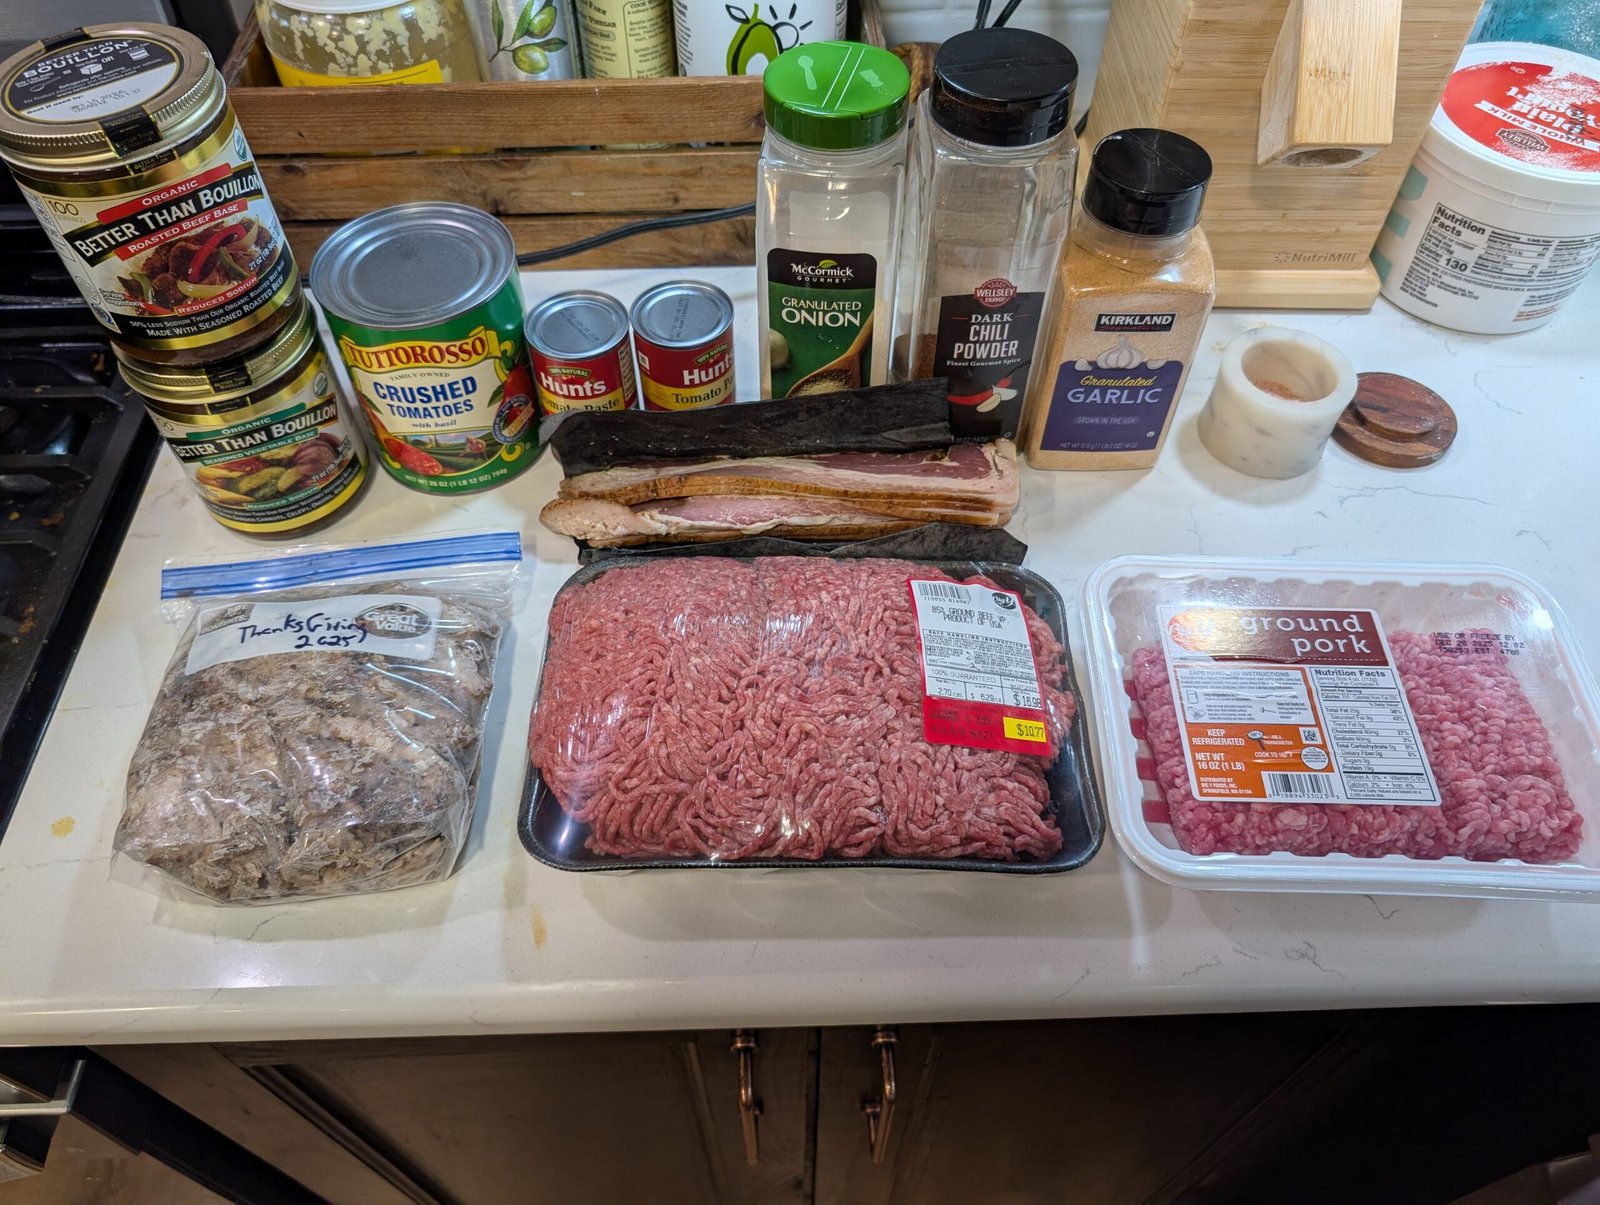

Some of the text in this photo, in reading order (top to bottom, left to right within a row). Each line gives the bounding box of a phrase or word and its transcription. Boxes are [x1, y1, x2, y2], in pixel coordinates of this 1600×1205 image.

[23, 41, 129, 78] BOUILLON
[38, 51, 80, 67] BETTER
[82, 42, 112, 53] THAN
[101, 56, 115, 64] OR
[1486, 106, 1586, 146] WHOLE MILK
[1499, 131, 1546, 151] WELLSLEY
[142, 179, 198, 206] ORGANIC
[49, 200, 79, 216] 100
[74, 174, 261, 258] BETTER THAN BOUILLON
[1432, 215, 1462, 238] Facts
[1436, 206, 1486, 235] Nutrition
[128, 204, 239, 254] ROASTED BEEF BASE
[1292, 252, 1356, 263] NutriMill
[1445, 257, 1468, 272] 130
[248, 262, 256, 271] 21
[790, 263, 855, 280] McCormick
[797, 276, 848, 284] GOURMET
[177, 277, 258, 314] REDUCED SODIUM
[976, 288, 1016, 299] WELLSLEY
[146, 276, 285, 337] MADE WITH SEASONED ROASTED BEEF
[147, 281, 271, 328] LESS SODIUM THAN OUR ORGANIC ROASTED
[781, 297, 862, 312] GRANULATED
[781, 308, 861, 328] ONION
[970, 313, 1014, 324] DARK
[1100, 315, 1172, 326] KIRKLAND
[968, 324, 1011, 342] CHILI
[345, 335, 486, 369] TUTTOROSSO
[953, 340, 1020, 360] POWDER
[946, 360, 969, 368] Finest
[1003, 358, 1022, 366] Spice
[388, 373, 418, 382] FAMILY
[561, 368, 589, 377] NATURAL
[1080, 375, 1158, 387] Granulated
[373, 376, 477, 404] CRUSHED
[671, 386, 720, 405] Tomato
[1066, 387, 1162, 404] GARLIC
[386, 399, 474, 420] TOMATOES
[172, 402, 336, 458] BETTER THAN BOUILLON
[221, 417, 271, 435] ORGANIC
[434, 420, 457, 428] basil
[203, 431, 316, 465] SEASONED VEGETABLE BASE
[248, 486, 319, 510] REDUCED SODIUM
[364, 612, 420, 626] Great
[931, 606, 995, 621] 85% GROUND BEEF
[943, 614, 974, 625] PRODUCT
[989, 620, 1003, 629] USA
[375, 621, 416, 633] Value
[1239, 614, 1364, 635] ground
[946, 632, 980, 641] HANDLING
[982, 636, 1027, 648] INSTRUCTIONS
[1291, 634, 1372, 656] pork
[951, 670, 996, 684] GUARANTEED
[1314, 669, 1357, 677] Nutrition
[1013, 694, 1042, 709] $16.98
[1016, 723, 1044, 738] $10.77
[1207, 729, 1225, 737] KEEP
[1192, 737, 1245, 746] REFRIGERATED
[1195, 753, 1225, 761] NET WT
[1197, 762, 1245, 771] 16 OZ (1 LB)
